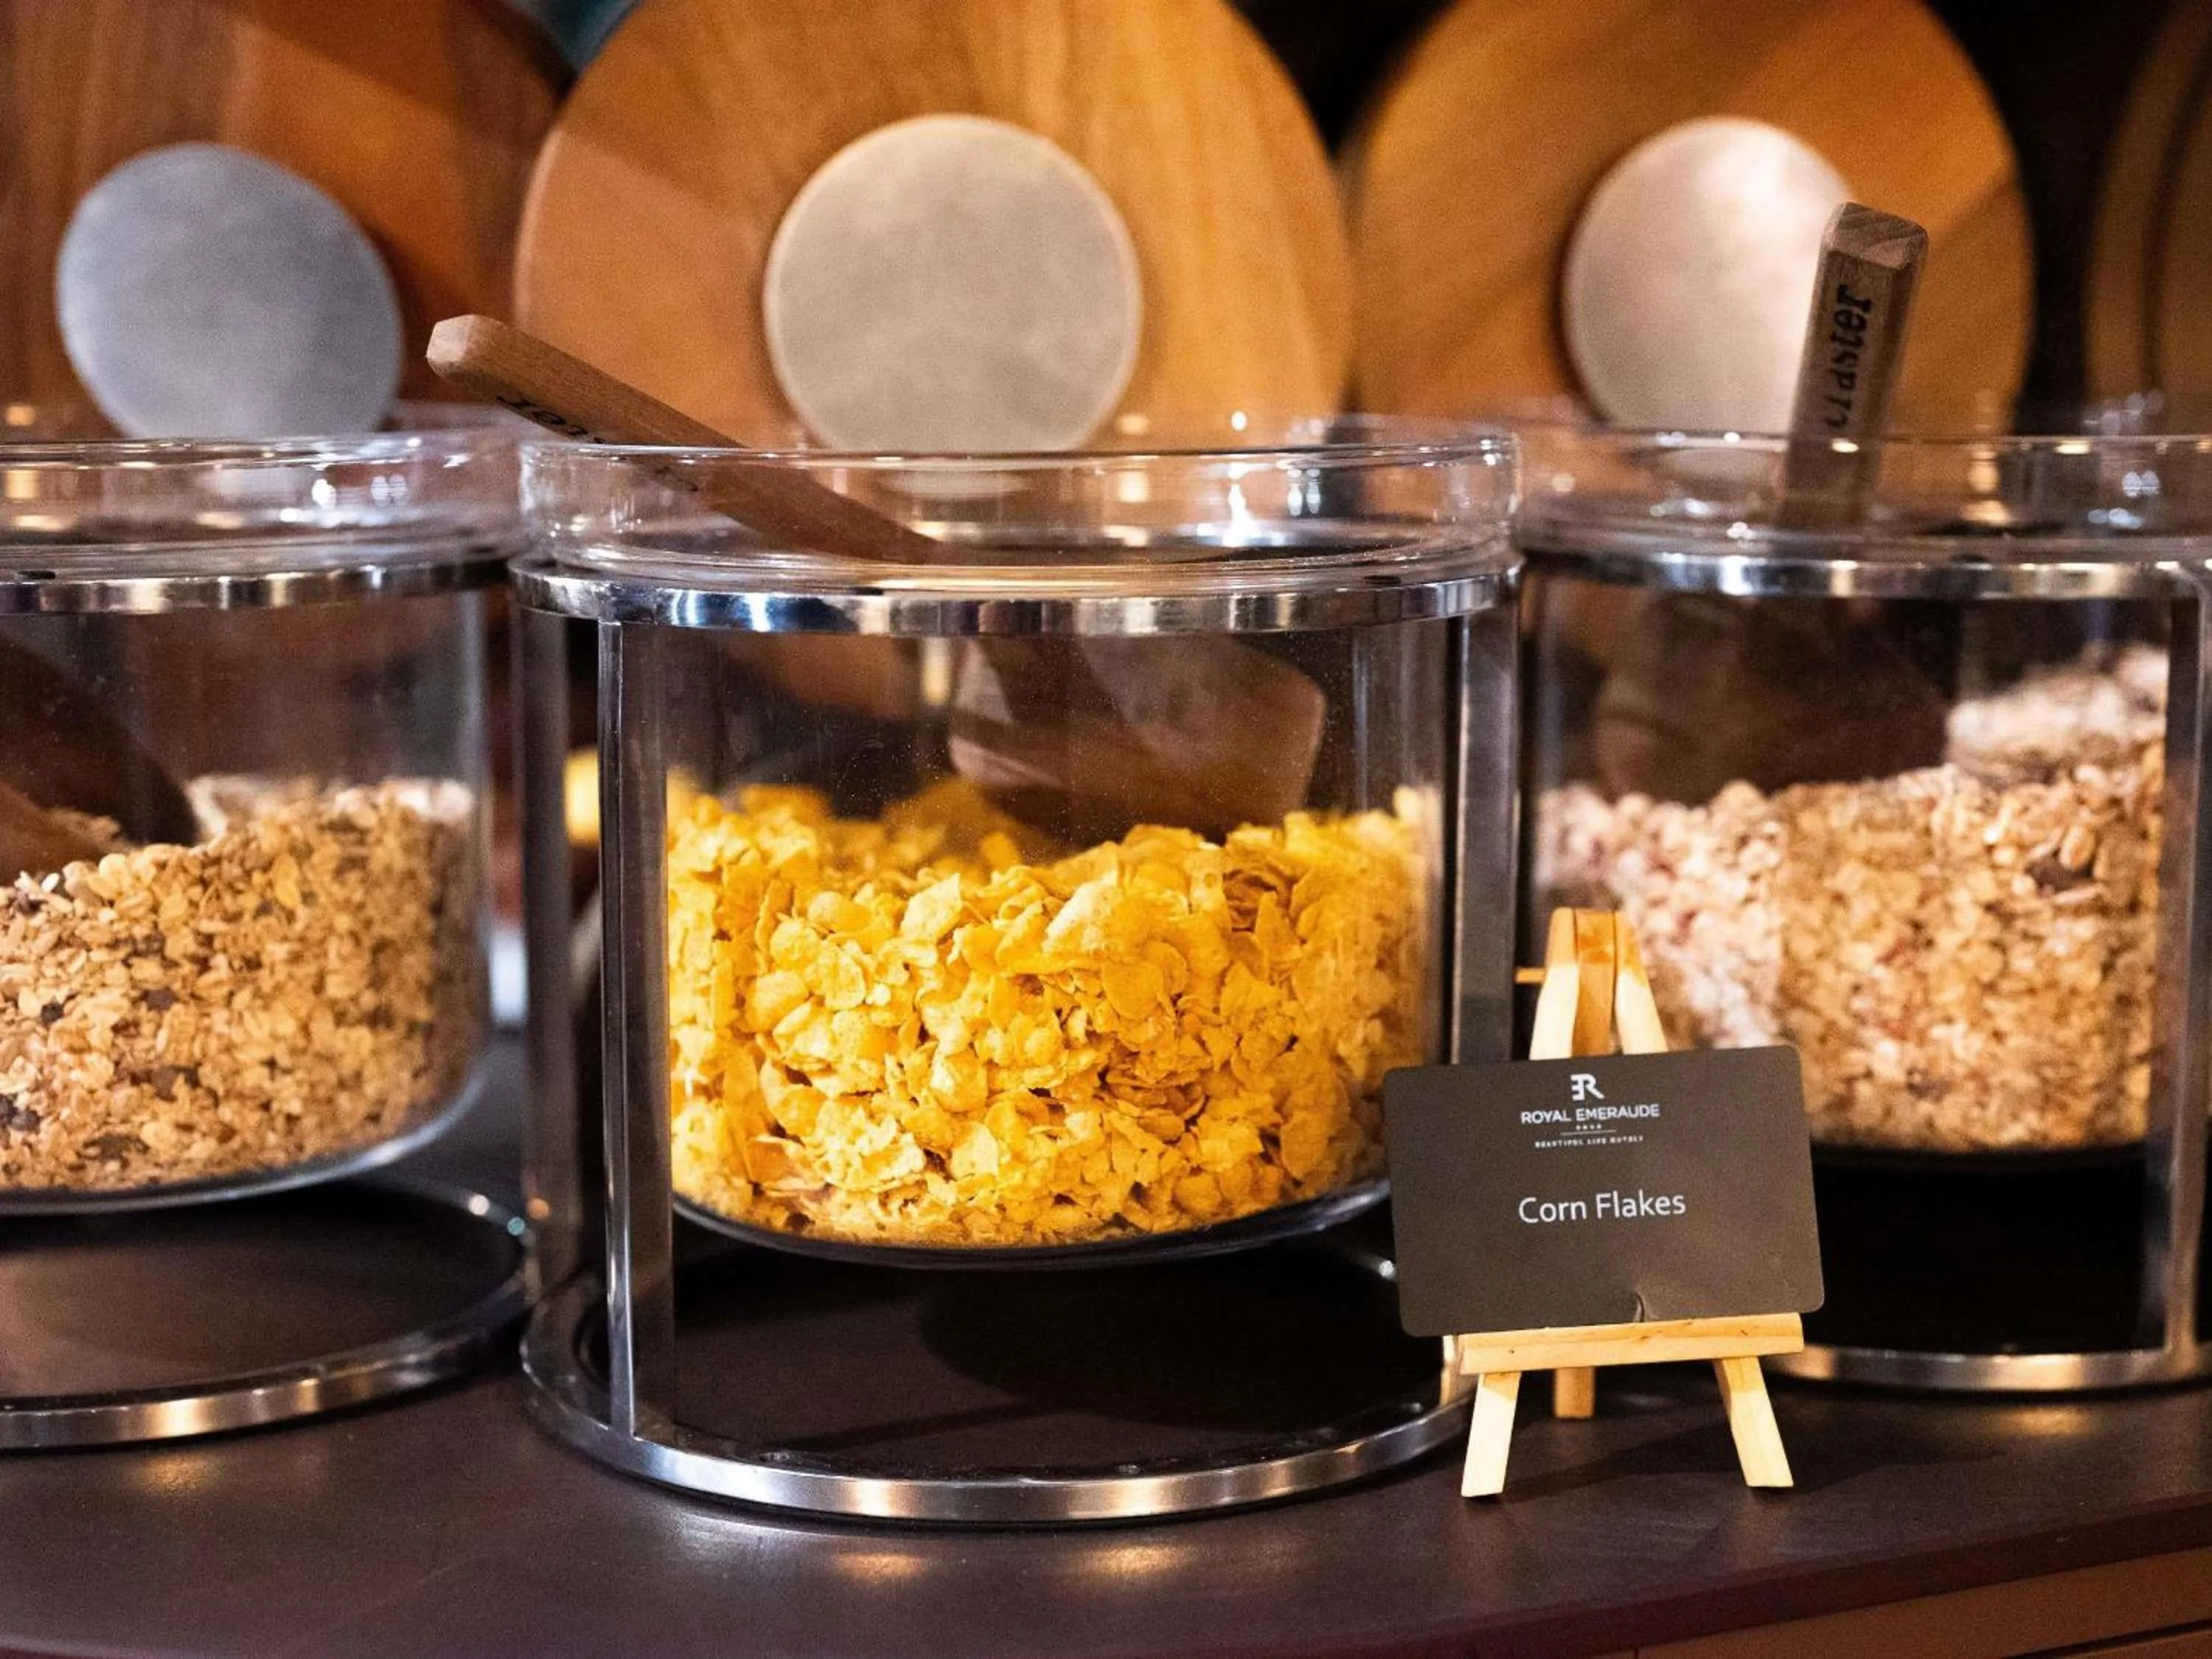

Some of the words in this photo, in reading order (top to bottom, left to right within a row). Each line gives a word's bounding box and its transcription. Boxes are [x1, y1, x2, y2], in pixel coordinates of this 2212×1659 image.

[1520, 1110, 1571, 1124] ROYAL
[1575, 1104, 1660, 1121] EMERAUDE
[1518, 1197, 1587, 1223] Corn
[1595, 1189, 1686, 1219] Flakes
